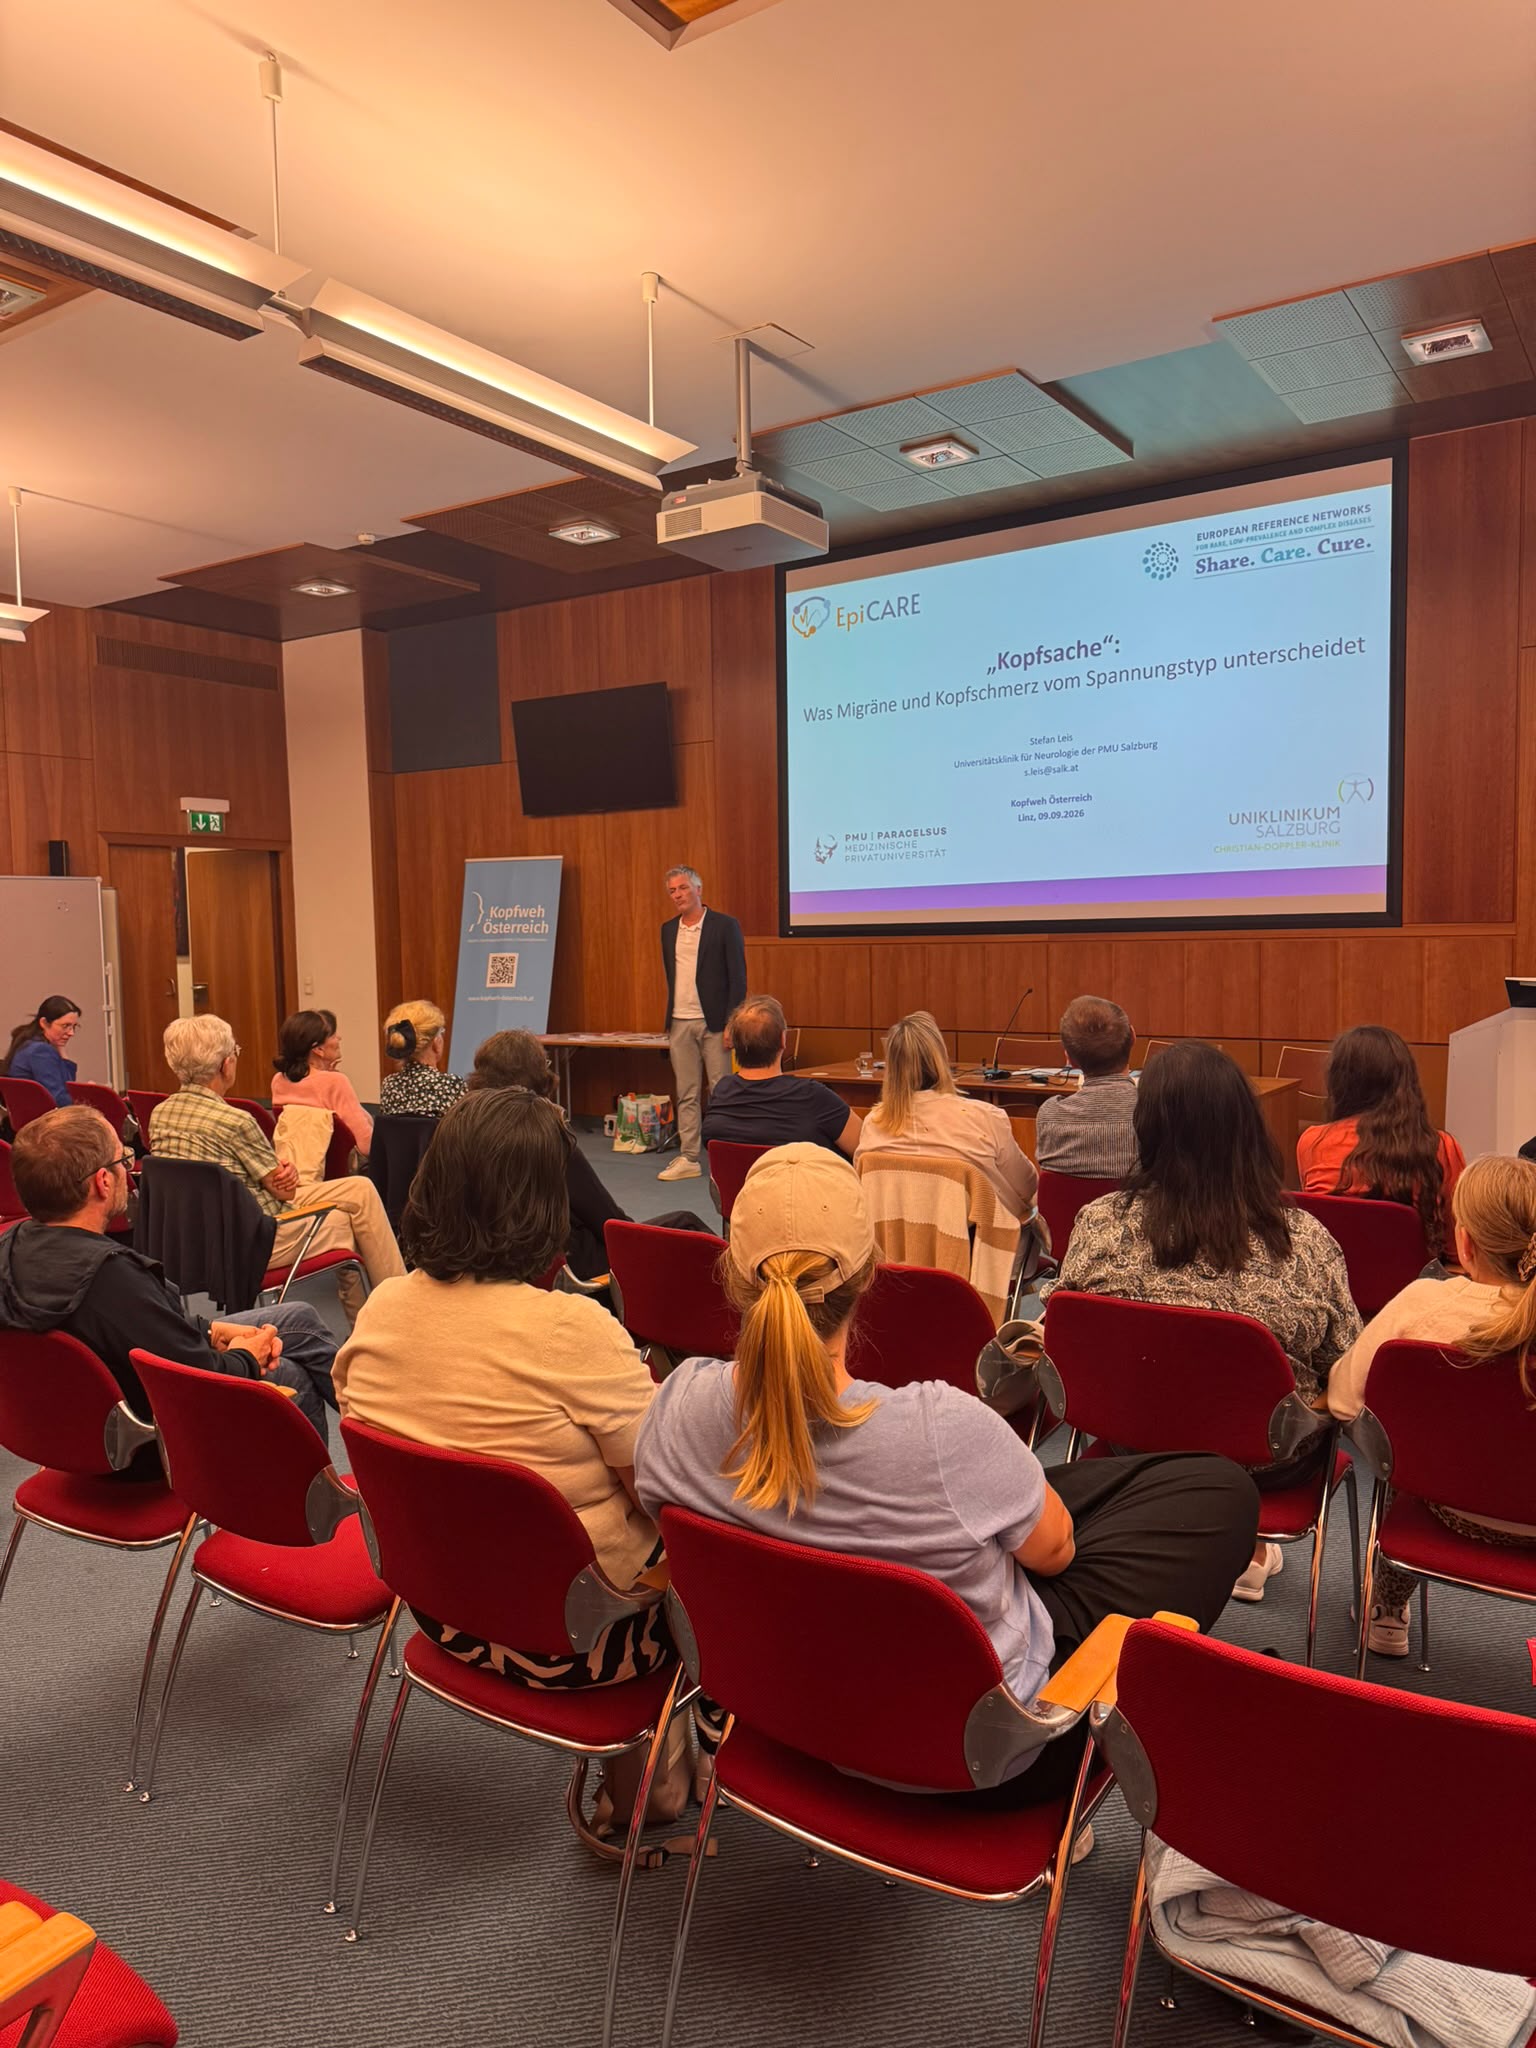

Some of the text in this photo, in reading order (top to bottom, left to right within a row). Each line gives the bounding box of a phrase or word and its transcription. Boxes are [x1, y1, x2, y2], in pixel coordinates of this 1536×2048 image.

[1196, 504, 1371, 541] EUROPEAN REFERENCE NETWORKS
[1304, 522, 1337, 534] COMPLEX
[1338, 516, 1372, 528] DISEASES
[1195, 537, 1372, 575] Share. Care. Cure.
[836, 593, 921, 632] EpiCARE
[803, 636, 1366, 722] Was Migräne und Kopfschmerz vom Spannungstyp unterscheidet
[1030, 733, 1073, 746] Stefan Leis
[1020, 751, 1033, 762] für
[1034, 749, 1080, 761] Neurologie
[1081, 747, 1096, 756] der
[1097, 744, 1119, 754] PMU
[1120, 740, 1158, 752] Salzburg
[1023, 763, 1079, 777] s.leis@salk.at
[1010, 792, 1093, 809] Kopfweh Österreich
[1017, 809, 1085, 823] Linz, 09.09.2026
[1228, 806, 1341, 825] UNIKLINIKUM
[844, 827, 947, 842] PMU PARACELSUS
[1255, 820, 1341, 839] SALZBURG
[844, 840, 918, 853] MEDIZINISCHE
[1214, 840, 1340, 853] CHRISTIAN-DOPPLER-KLINIK
[844, 848, 947, 863] PRIVATUNIVERSITÄT
[490, 905, 545, 920] Kopfweh
[483, 919, 549, 934] Österreich
